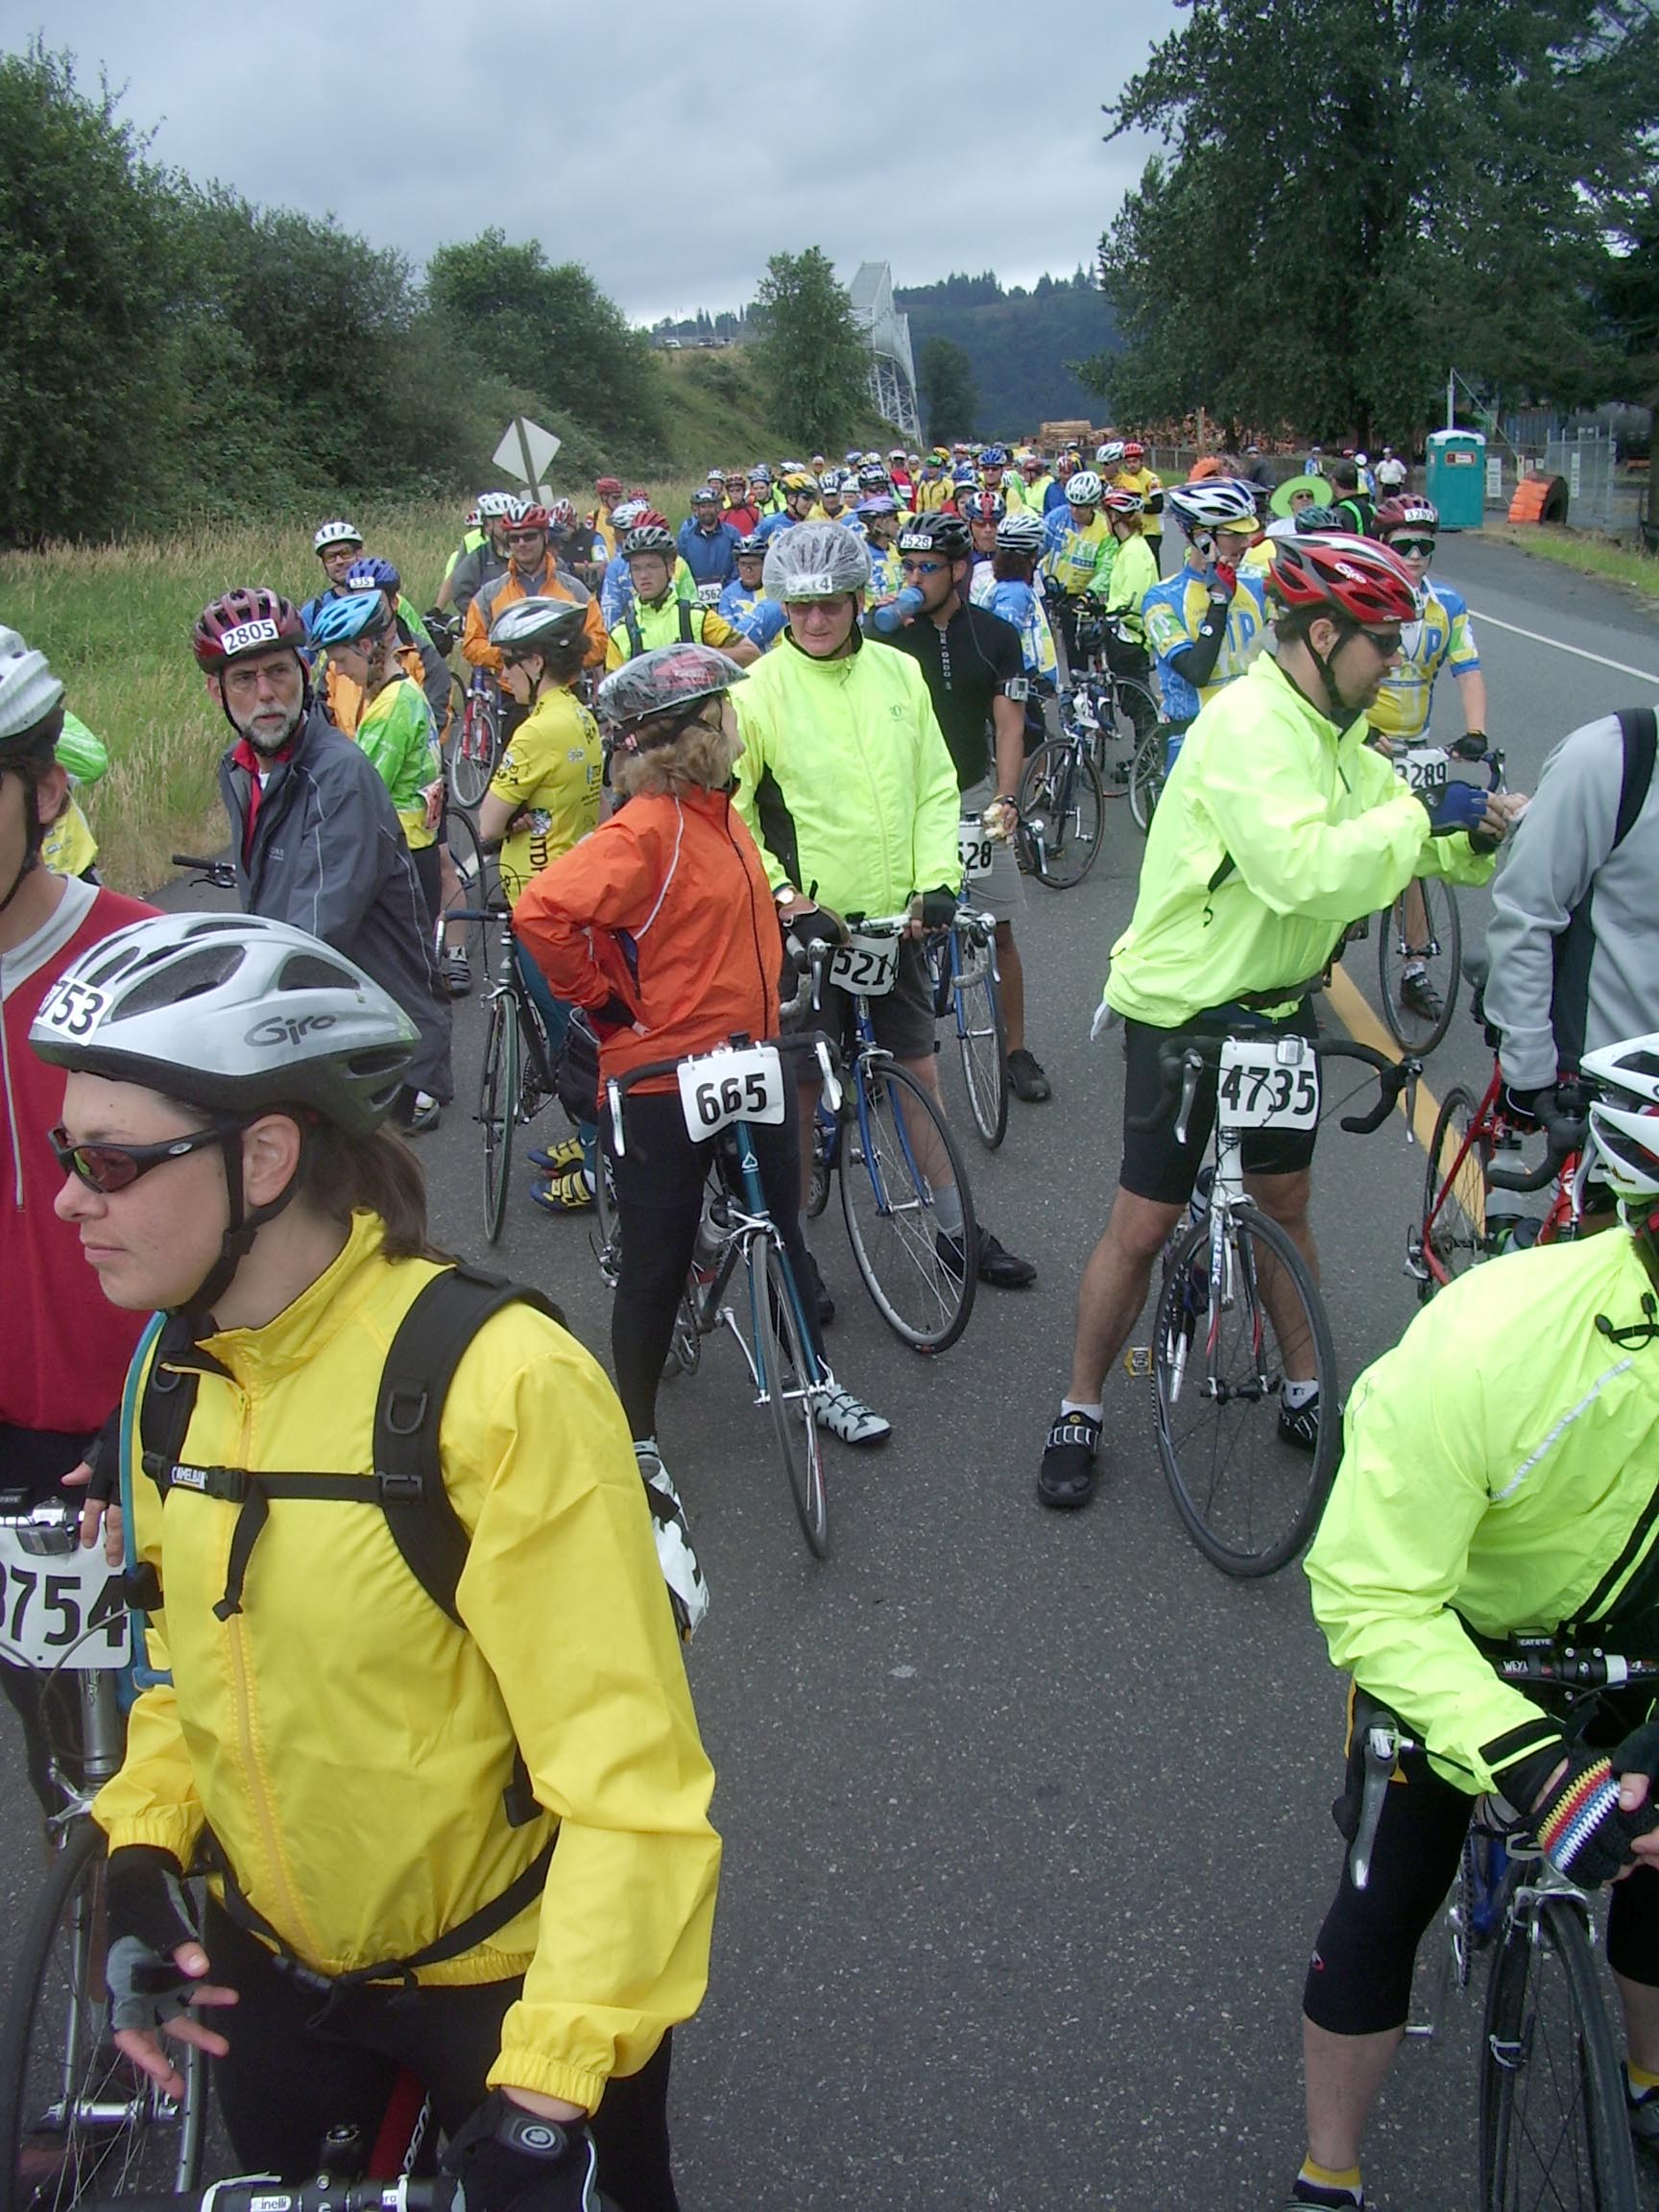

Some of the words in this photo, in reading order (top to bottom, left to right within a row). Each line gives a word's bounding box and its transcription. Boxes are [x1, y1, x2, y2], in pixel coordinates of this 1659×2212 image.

[225, 621, 276, 652] 2805
[39, 979, 105, 1036] 753
[244, 1015, 336, 1047] Giro
[695, 1071, 767, 1126] 665
[1220, 1064, 1315, 1116] 4735
